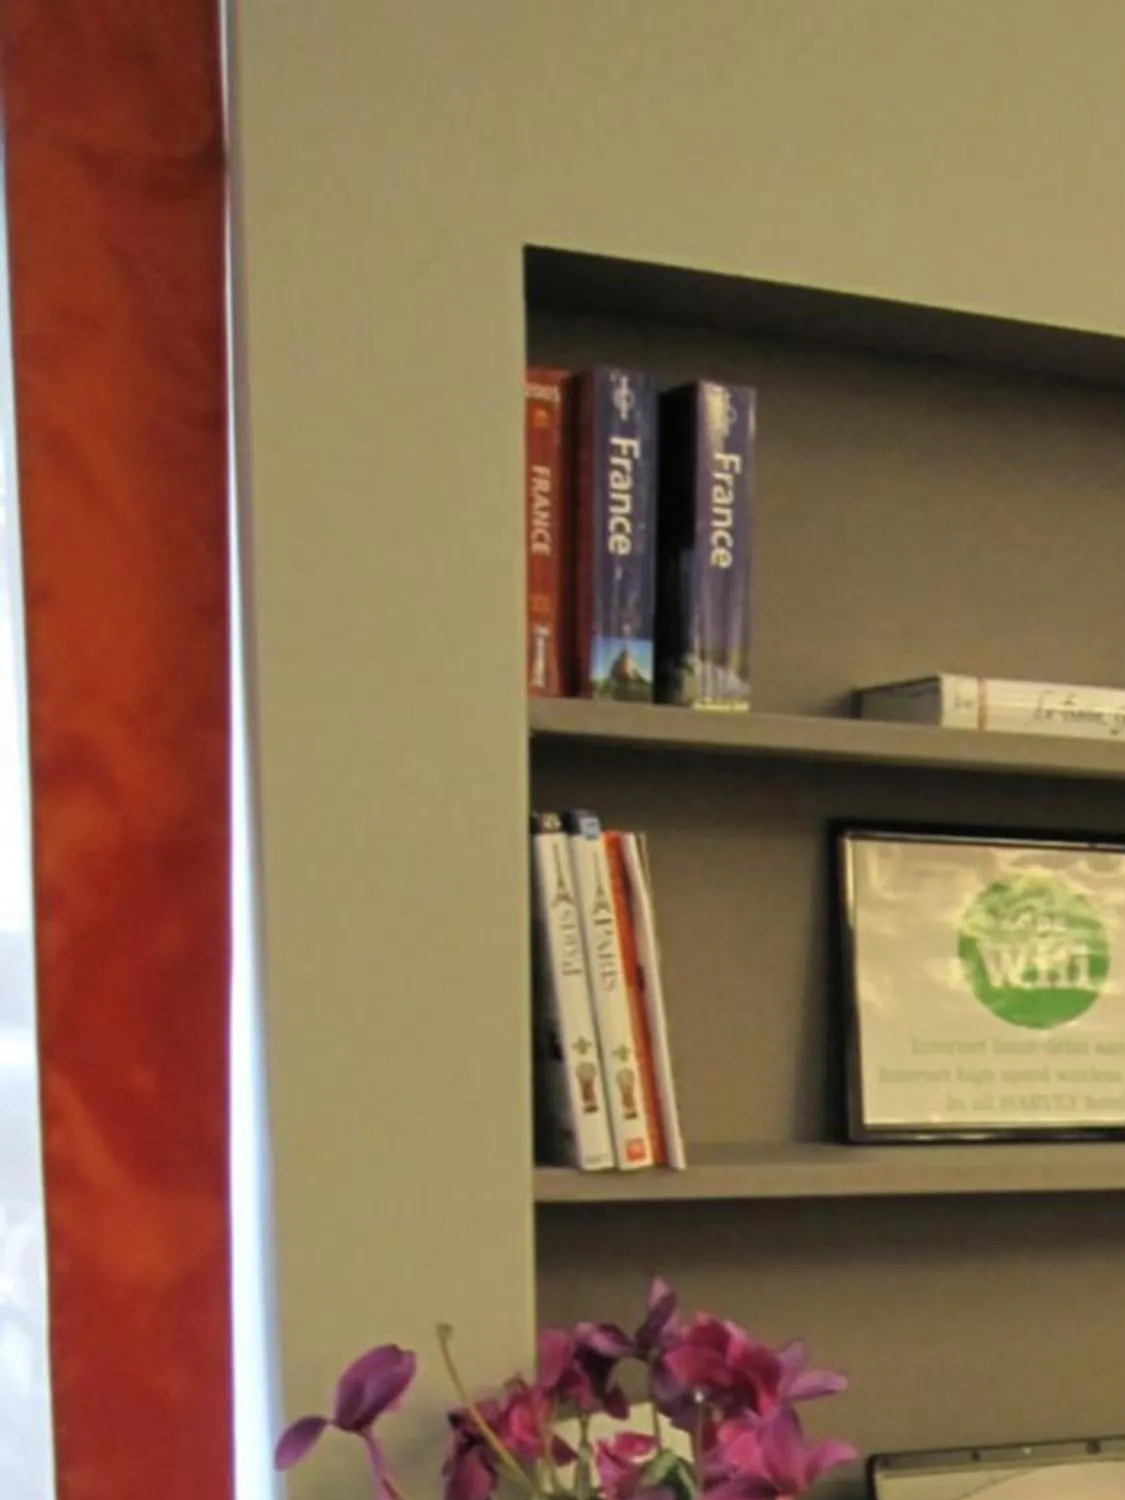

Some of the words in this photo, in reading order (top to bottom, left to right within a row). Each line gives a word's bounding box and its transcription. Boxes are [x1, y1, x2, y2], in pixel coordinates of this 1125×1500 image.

[531, 464, 551, 557] FRANCE
[607, 435, 641, 556] France
[709, 451, 742, 568] France
